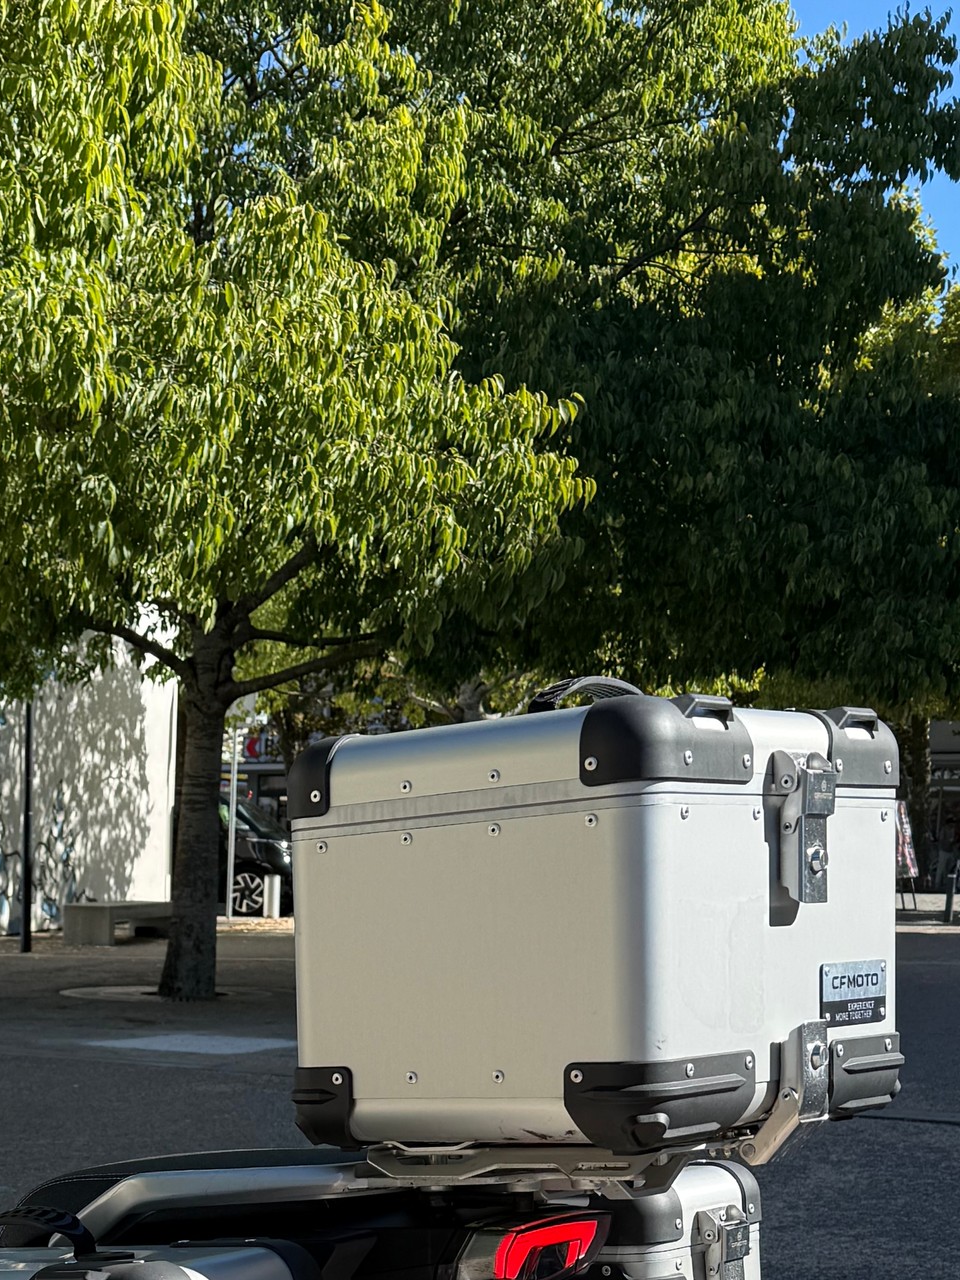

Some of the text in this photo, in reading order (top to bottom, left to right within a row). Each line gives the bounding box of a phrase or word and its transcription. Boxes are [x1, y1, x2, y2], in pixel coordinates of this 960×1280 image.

[831, 972, 879, 990] CFMOTO
[847, 1000, 875, 1011] EXPERIENCE
[835, 1009, 872, 1021] MORE TOGETHER
